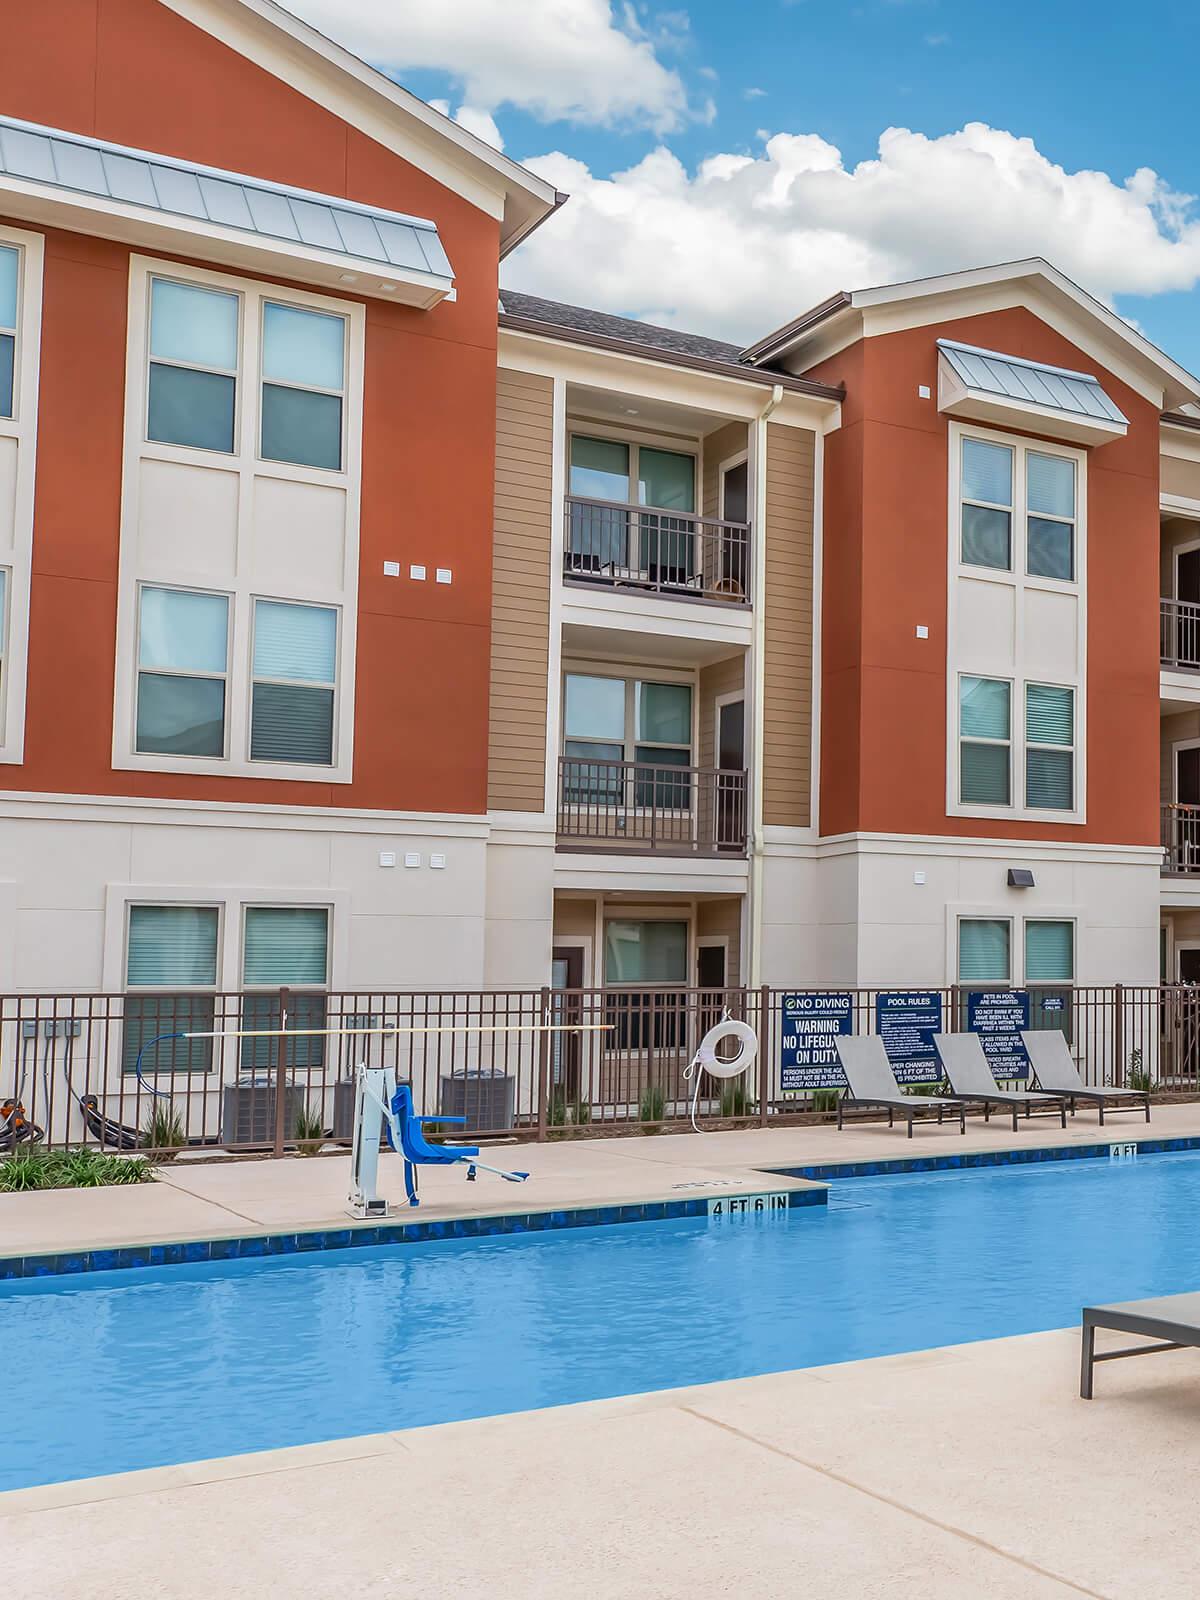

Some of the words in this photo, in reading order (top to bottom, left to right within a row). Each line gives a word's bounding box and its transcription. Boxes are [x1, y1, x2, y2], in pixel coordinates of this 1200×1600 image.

[796, 998, 812, 1009] NO
[815, 998, 849, 1009] DIVING
[887, 998, 907, 1006] POOL
[795, 1019, 839, 1034] WARNING
[783, 1036, 797, 1048] NO
[796, 1050, 810, 1064] ON
[812, 1050, 838, 1063] DUTY
[1113, 1147, 1119, 1156] 4
[1124, 1145, 1136, 1158] FT
[713, 1202, 723, 1214] 4
[730, 1200, 748, 1213] FT
[754, 1198, 764, 1211] 6
[771, 1195, 787, 1209] IN
